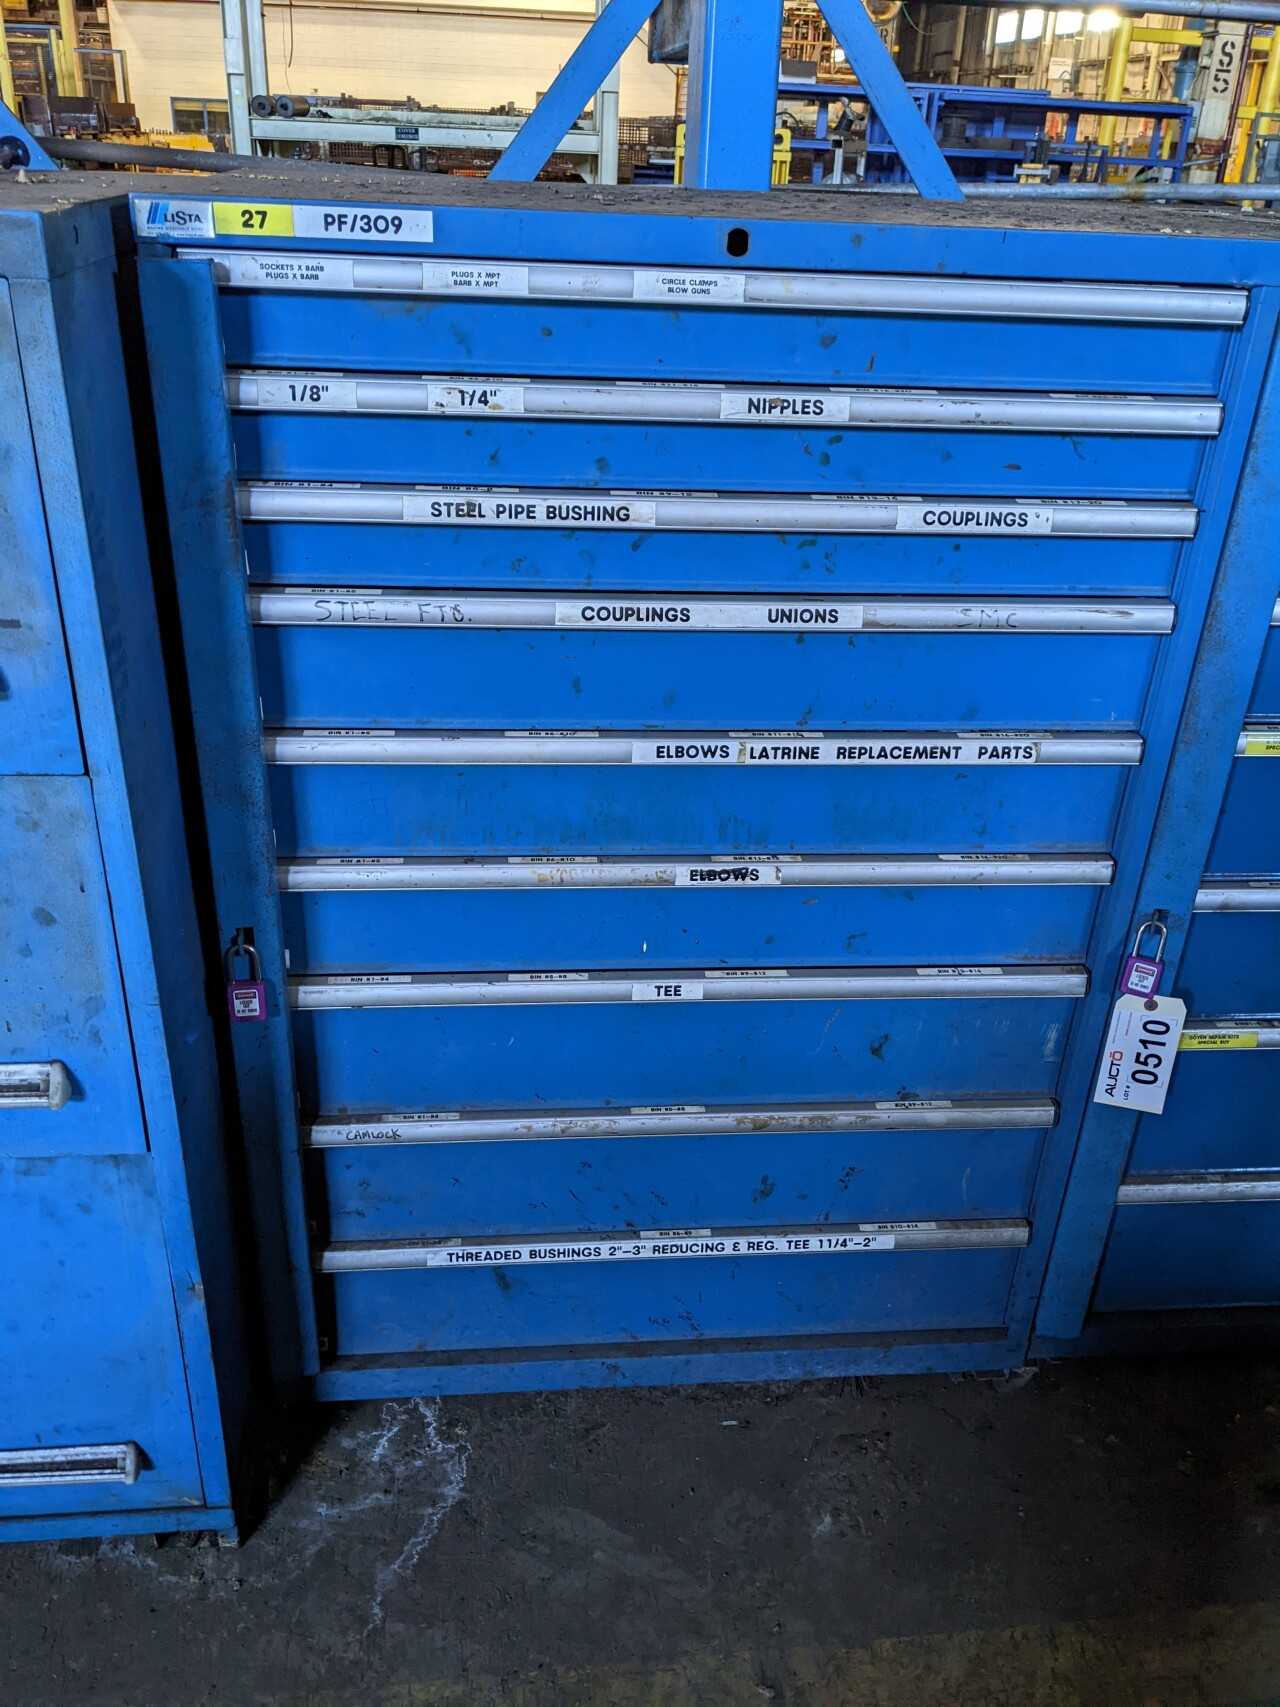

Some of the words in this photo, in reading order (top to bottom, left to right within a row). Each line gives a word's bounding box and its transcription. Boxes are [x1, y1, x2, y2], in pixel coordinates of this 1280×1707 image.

[240, 209, 268, 229] 27
[324, 214, 404, 235] PF/309
[259, 262, 295, 271] SOCKETS
[305, 264, 324, 272] BARB
[689, 279, 718, 287] CLAMPS
[288, 384, 329, 402] 1/8"
[458, 390, 497, 407] 1/4"
[748, 397, 824, 416] NIPPLES
[430, 502, 486, 518] STEEL
[496, 504, 537, 519] PIPE
[546, 505, 630, 521] BUSHING
[922, 510, 1028, 527] COUPLINGS
[314, 600, 398, 621] STEEL
[581, 606, 691, 623] COUPLINGS
[768, 608, 839, 624] UNIONS
[656, 745, 730, 758] ELBOWS
[749, 746, 820, 760] LATRINE
[836, 746, 962, 760] REPLACEMENT
[978, 746, 1033, 760] PARTS
[689, 867, 760, 882] ELBOWS
[654, 985, 682, 997] TEE
[1130, 1020, 1170, 1086] 0510
[345, 1128, 402, 1141] CAMLOCK
[446, 1249, 522, 1263] THREADED
[529, 1247, 601, 1260] BUSHINGS
[652, 1241, 725, 1254] REDUCING
[732, 1241, 741, 1252] &
[747, 1240, 778, 1252] REG.
[786, 1239, 810, 1250] TEE
